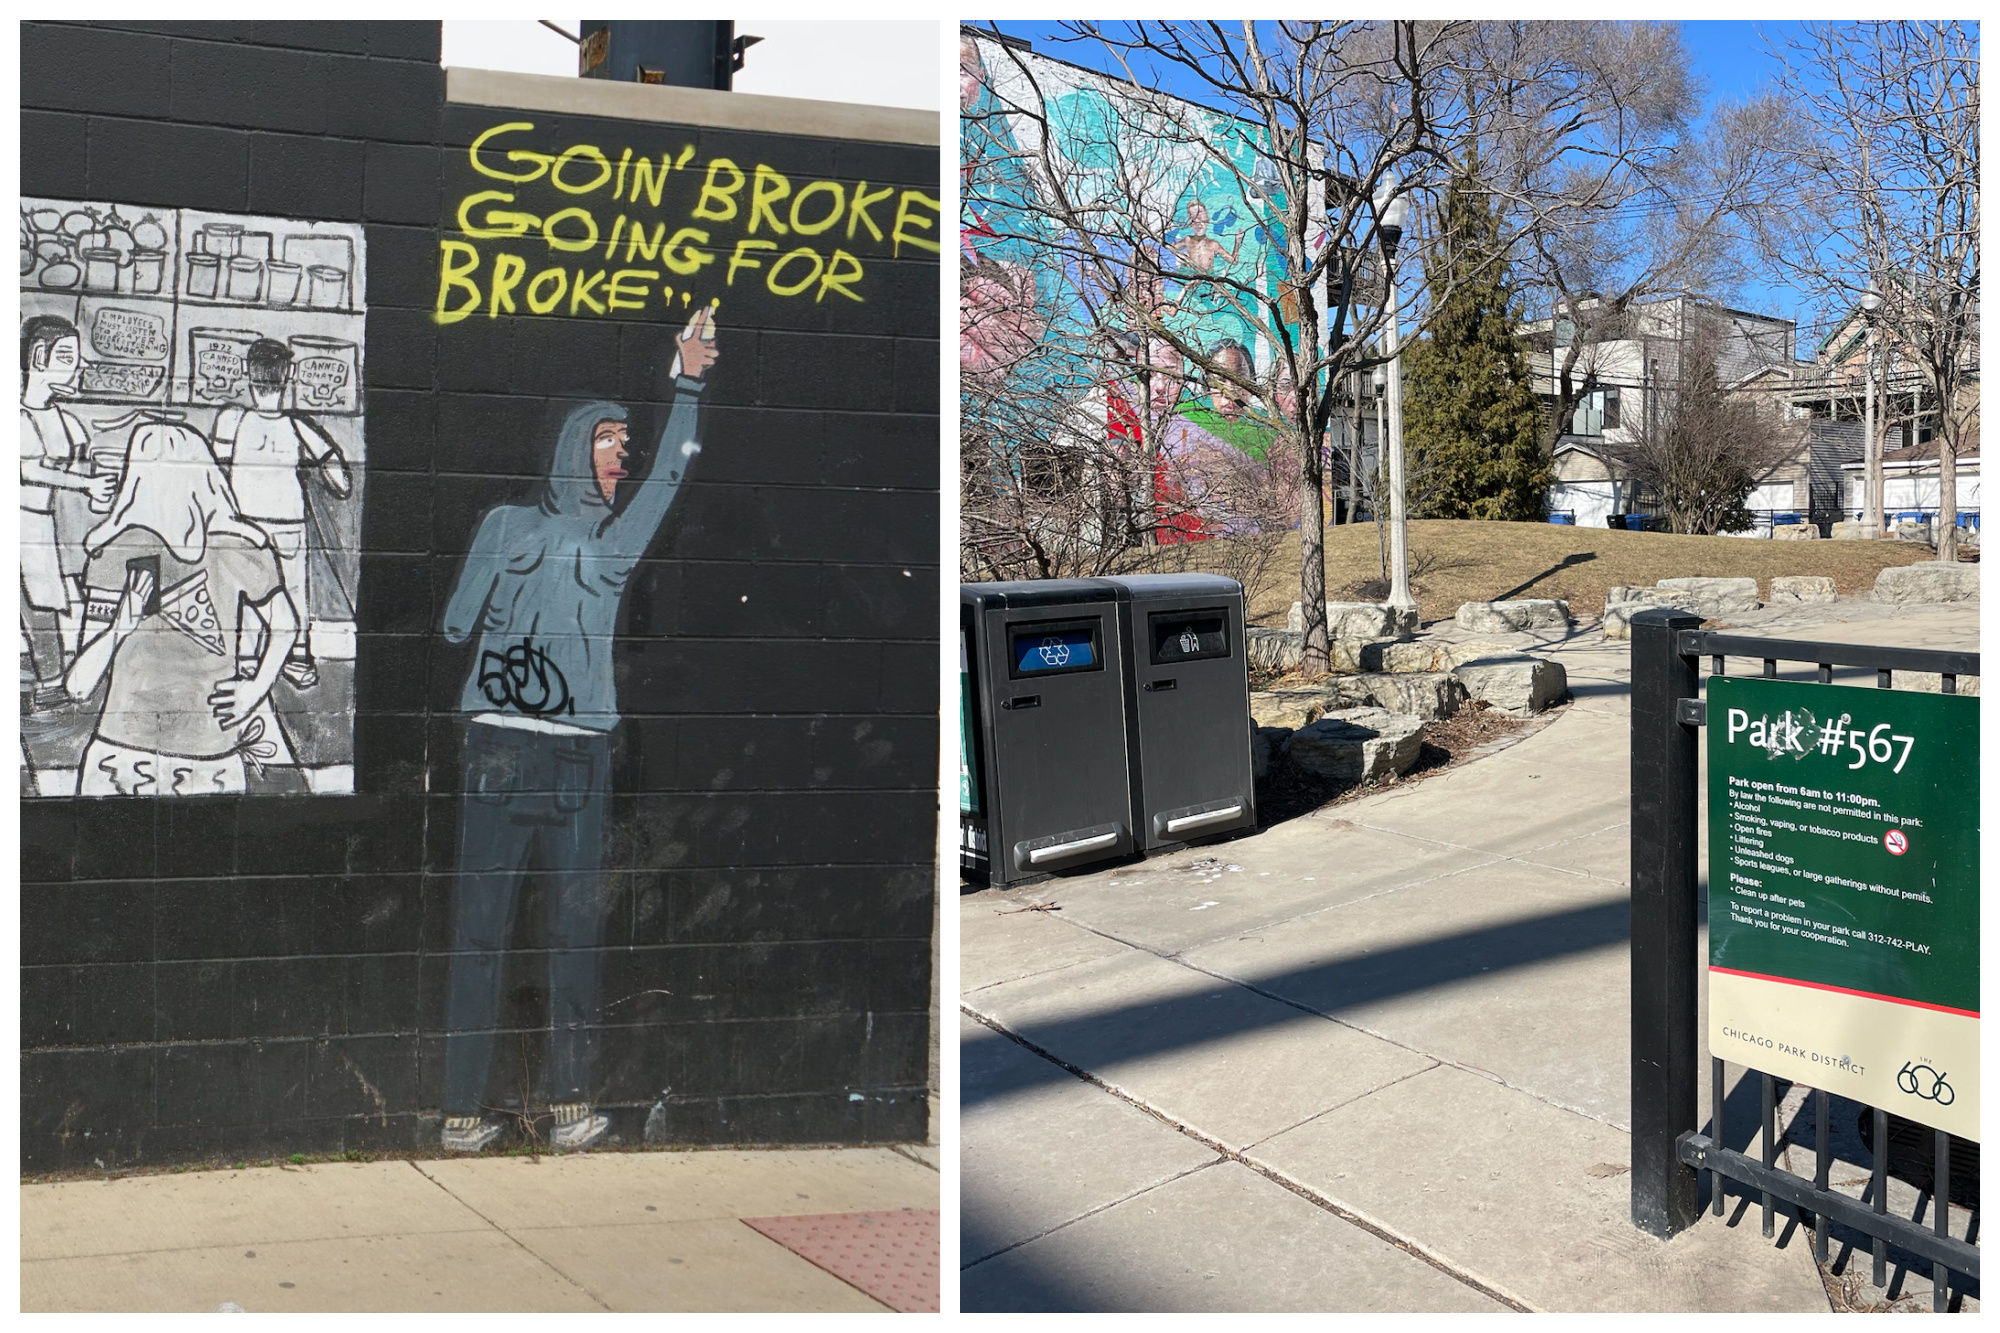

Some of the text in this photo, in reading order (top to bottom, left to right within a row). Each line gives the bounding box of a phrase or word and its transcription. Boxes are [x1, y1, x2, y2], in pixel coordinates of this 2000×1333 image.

[469, 122, 941, 256] GOIN' BROKE
[457, 190, 865, 304] GOING FOR
[100, 319, 156, 337] MUST LISTEN
[102, 311, 153, 329] EMPLOYEES
[94, 332, 121, 344] BEFORE
[98, 326, 156, 345] TO SLAYER
[96, 341, 145, 356] TO WORK
[202, 352, 239, 366] CANNED
[304, 360, 345, 373] CANNED
[201, 362, 241, 376] TOMATO
[301, 370, 342, 384] TOMATO
[1728, 708, 1915, 774] Park #567
[1728, 776, 1881, 807] Park open from 6am to 11:00pm.
[1728, 788, 1924, 828] By law the following are not permitted in this park:
[1733, 801, 1761, 813] Alcohol
[1734, 812, 1879, 845] Smoking, vaping, or tobacco products
[1734, 823, 1773, 838] Open fires
[1734, 834, 1765, 849] Littering
[1734, 845, 1795, 865] Unleashed dogs
[1730, 872, 1763, 888] Please:
[1734, 856, 1758, 869] Sports
[1759, 861, 1792, 876] leagues,
[1803, 869, 1823, 882] large
[1825, 875, 1868, 891] gatherings
[1869, 884, 1900, 897] without
[1735, 886, 1806, 908] Clean up after pets
[1730, 901, 1932, 955] To report a problem in your park call 312-742-PLAY.
[1730, 912, 1850, 948] Thank you for your cooperation.
[1722, 1026, 1866, 1077] CHICAGO PARK DISTRICT
[1897, 1060, 1955, 1106] 606
